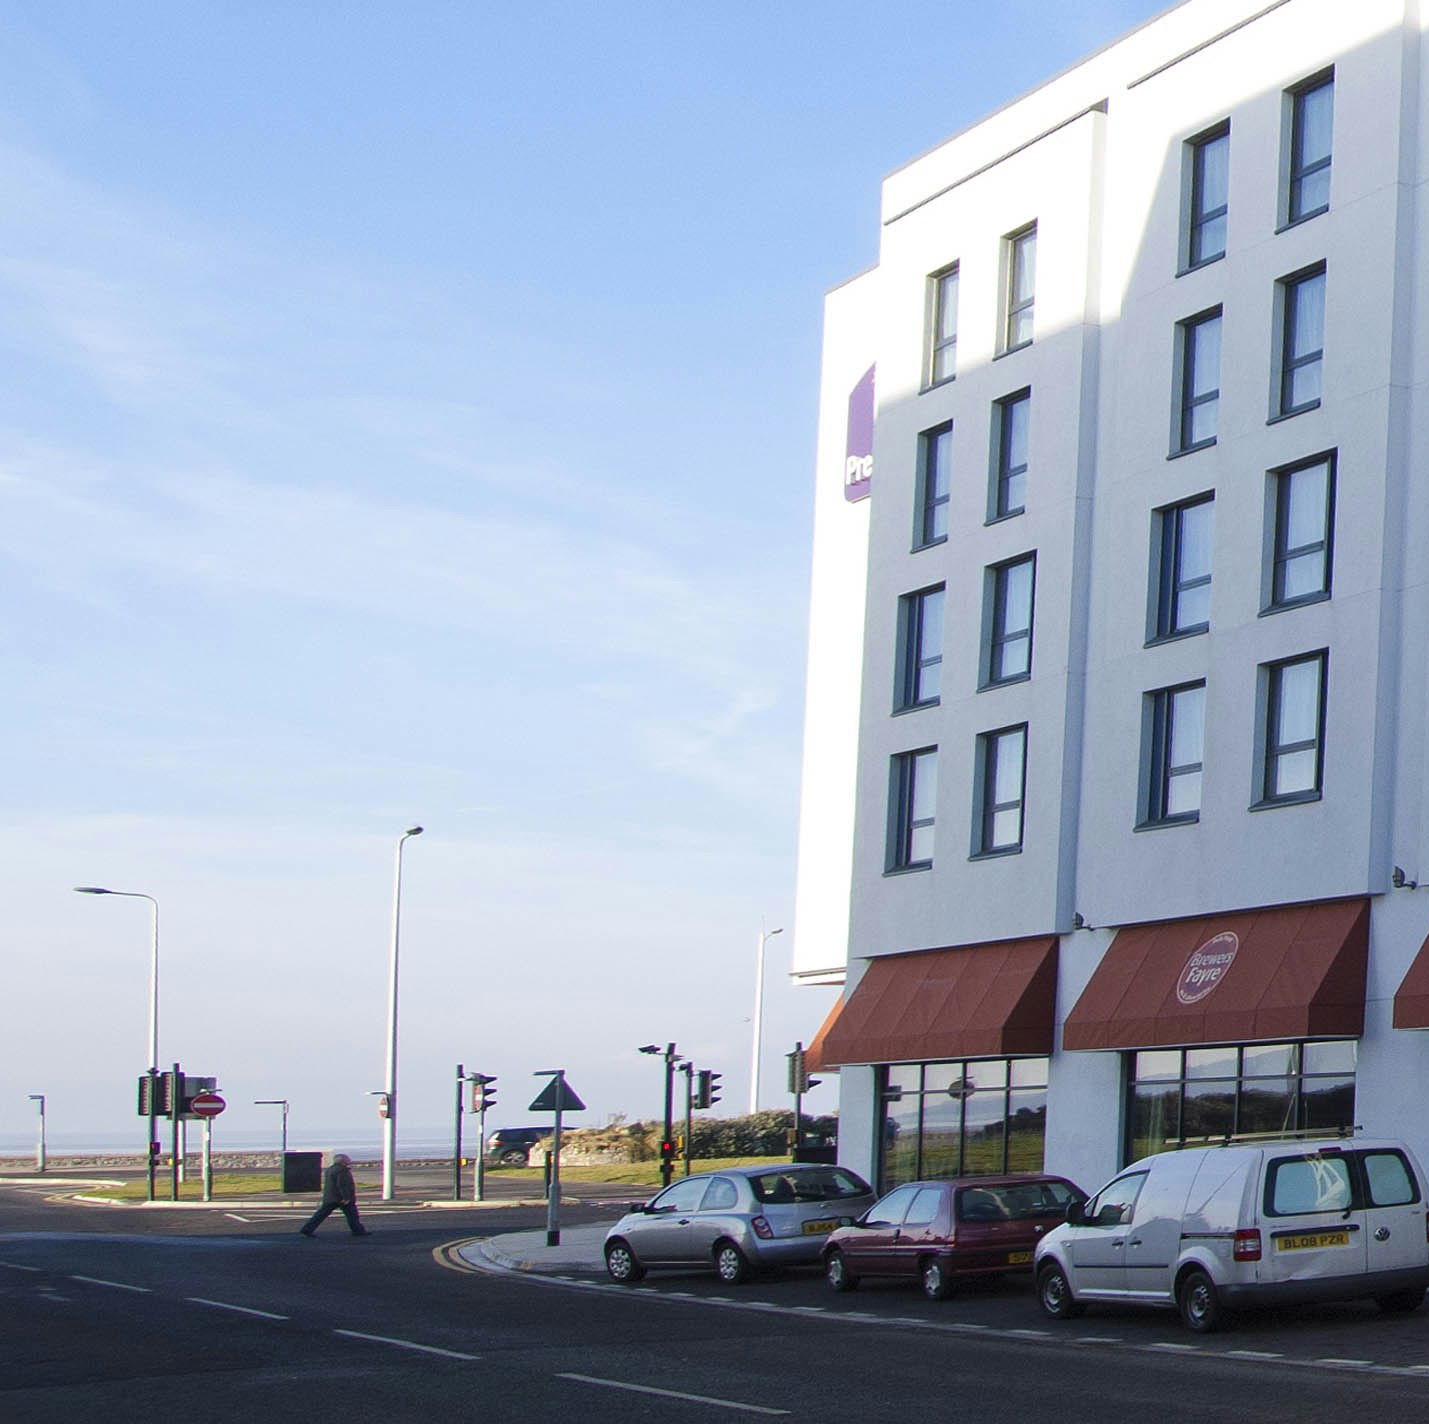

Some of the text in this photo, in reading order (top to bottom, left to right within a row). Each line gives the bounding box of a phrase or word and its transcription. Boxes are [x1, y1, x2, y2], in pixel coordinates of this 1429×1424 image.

[1191, 952, 1233, 966] Brewers
[1186, 967, 1221, 986] Fayre
[1284, 1234, 1345, 1249] BL08 PZR
